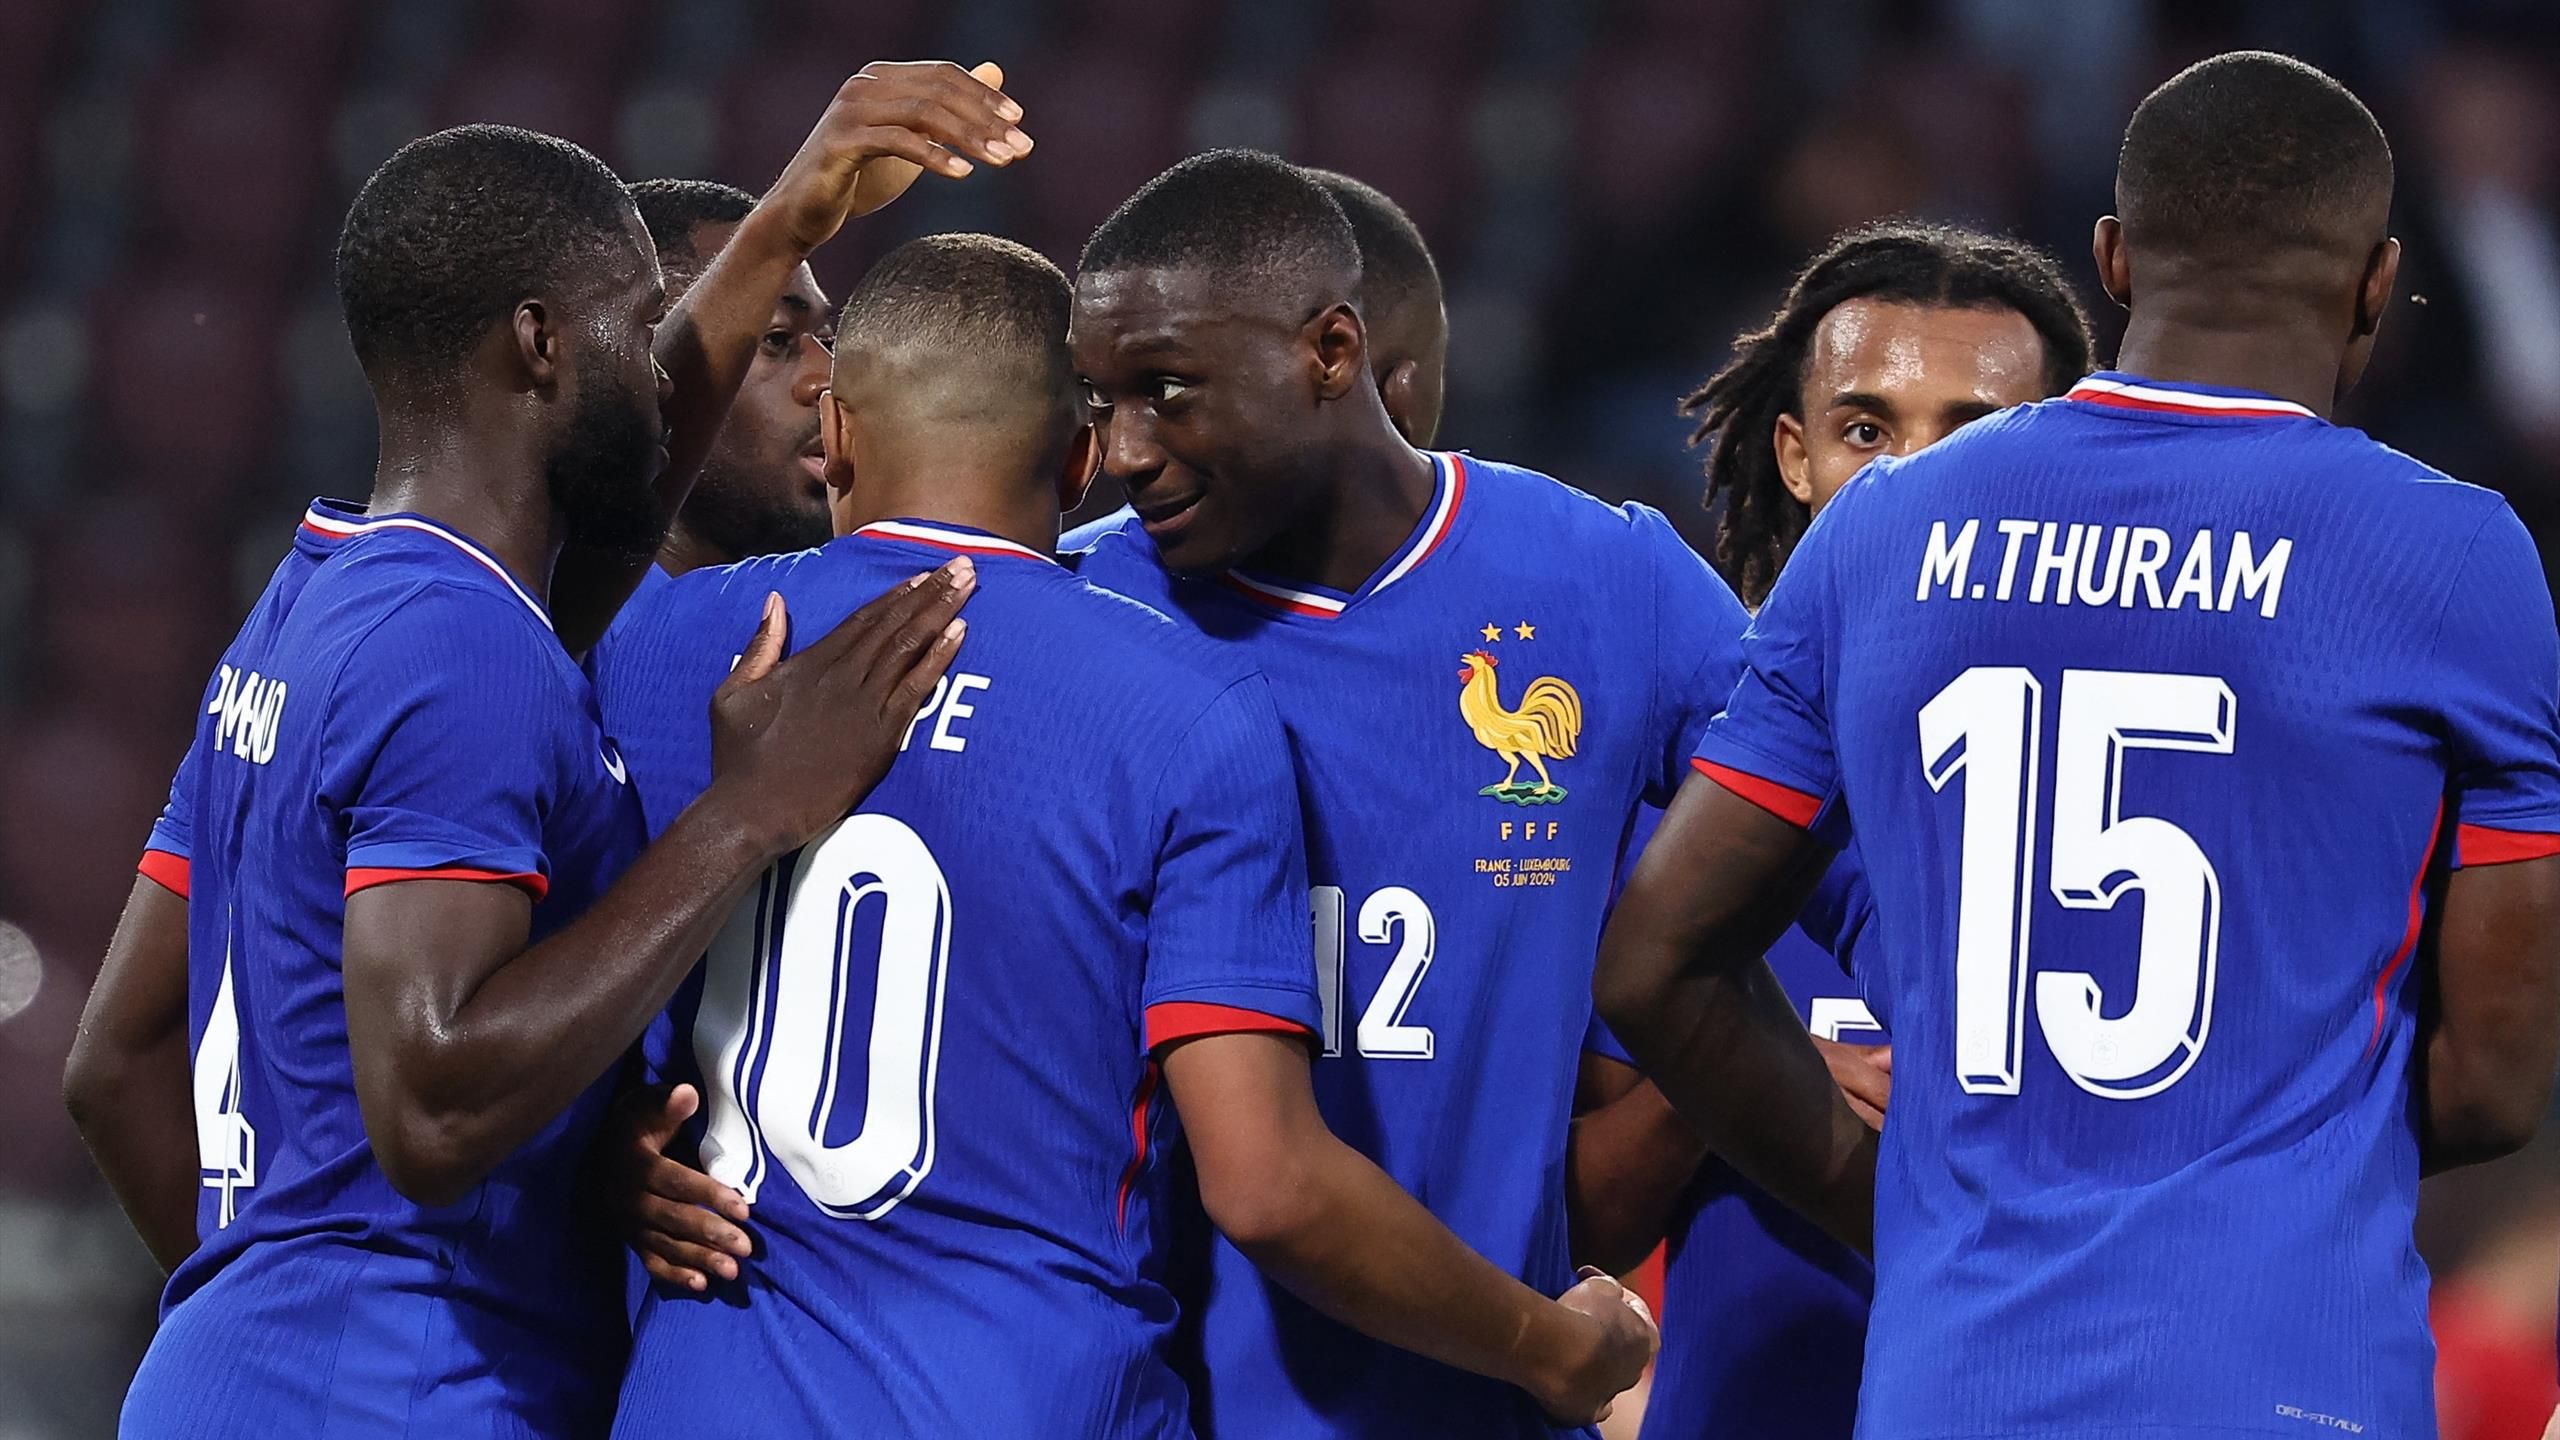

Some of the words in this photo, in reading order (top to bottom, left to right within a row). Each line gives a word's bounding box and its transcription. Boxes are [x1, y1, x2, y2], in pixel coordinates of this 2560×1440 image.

[1916, 519, 2293, 619] M.THURAM
[1475, 859, 1511, 873] FRANCE
[1520, 857, 1571, 872] LUXEMBOURG
[1494, 873, 1510, 887] 05
[1511, 873, 1528, 887] JUIN
[1529, 872, 1555, 886] 2024
[1918, 667, 2237, 1100] 15
[693, 813, 953, 1221] 10
[1309, 886, 1435, 1060] 12
